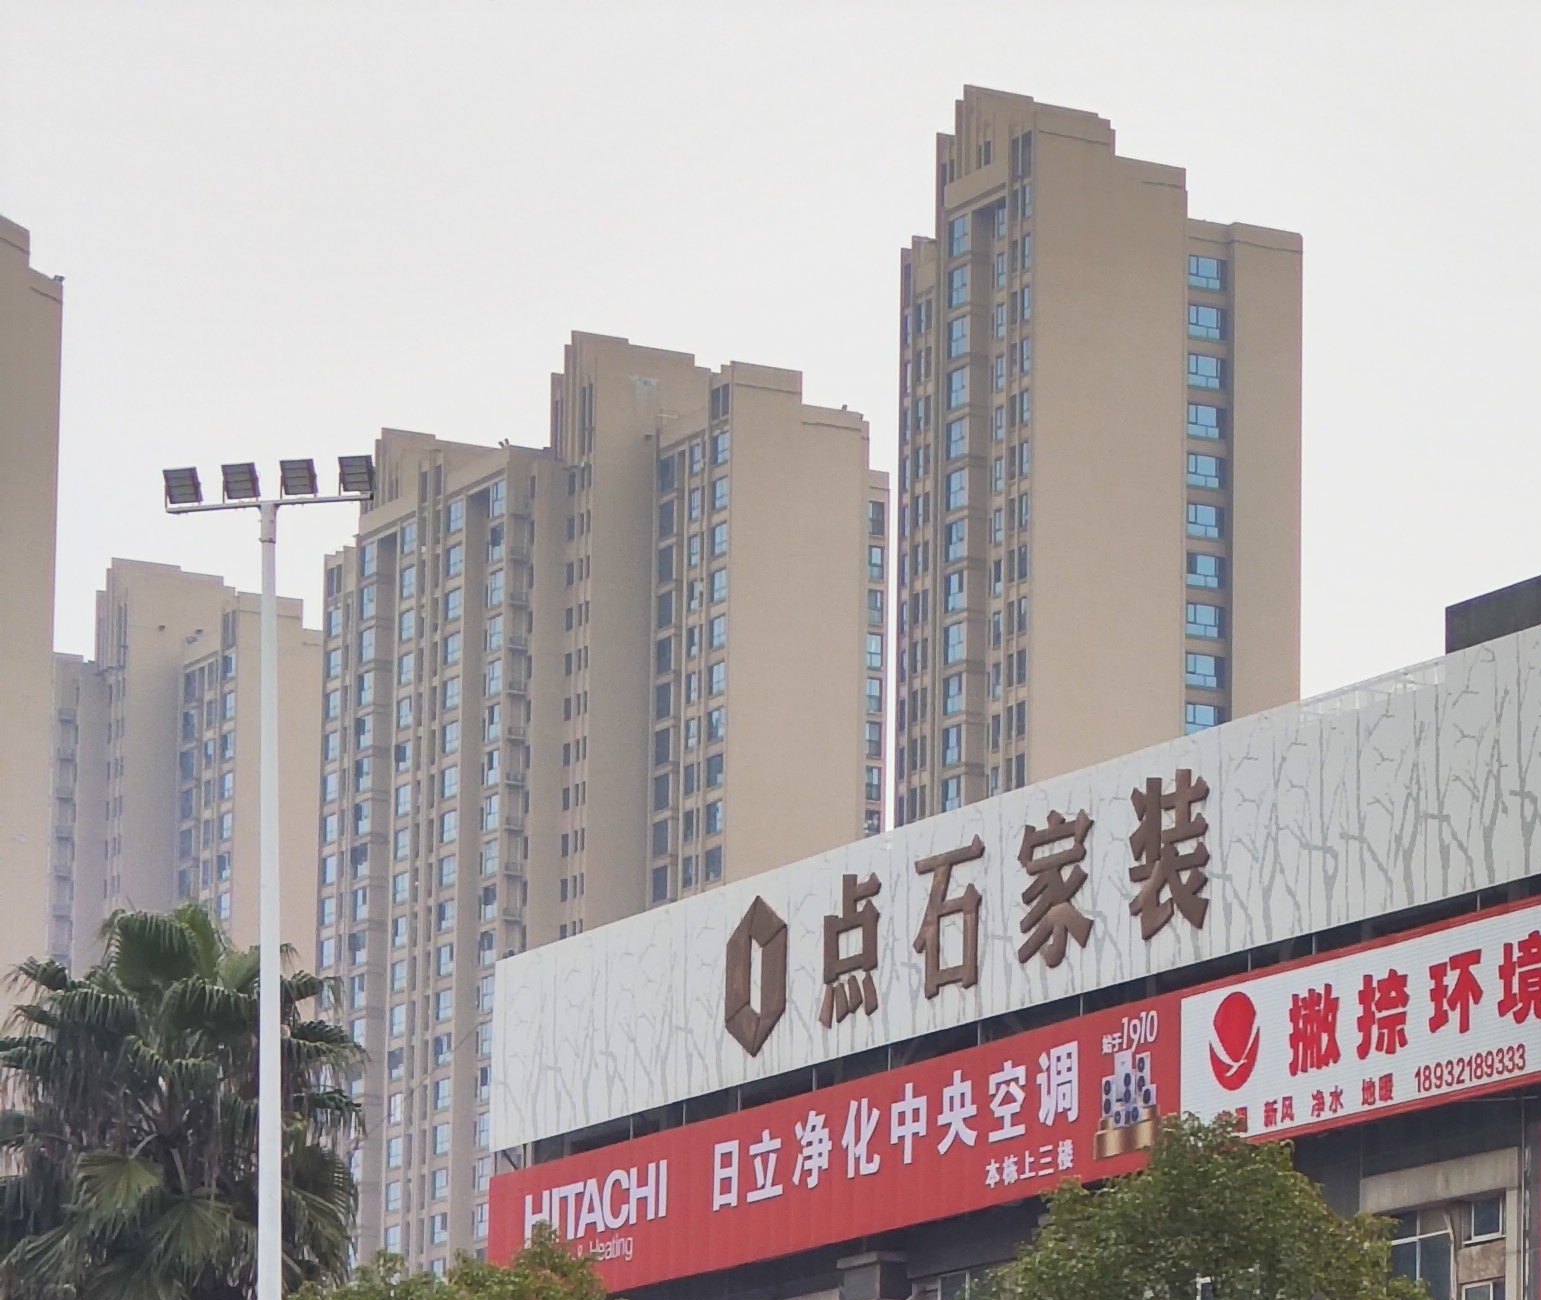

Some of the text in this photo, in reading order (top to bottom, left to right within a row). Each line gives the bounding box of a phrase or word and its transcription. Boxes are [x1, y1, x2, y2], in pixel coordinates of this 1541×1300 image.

[817, 767, 1212, 1028] 点石家装
[712, 1040, 1079, 1211] 日立净化中央空调
[1311, 1084, 1344, 1118] 净水
[1361, 1072, 1394, 1107] 地暖
[1414, 1043, 1527, 1093] 18932189333
[524, 1159, 668, 1249] HITACHI
[984, 1138, 1074, 1189] 本栋上三楼
